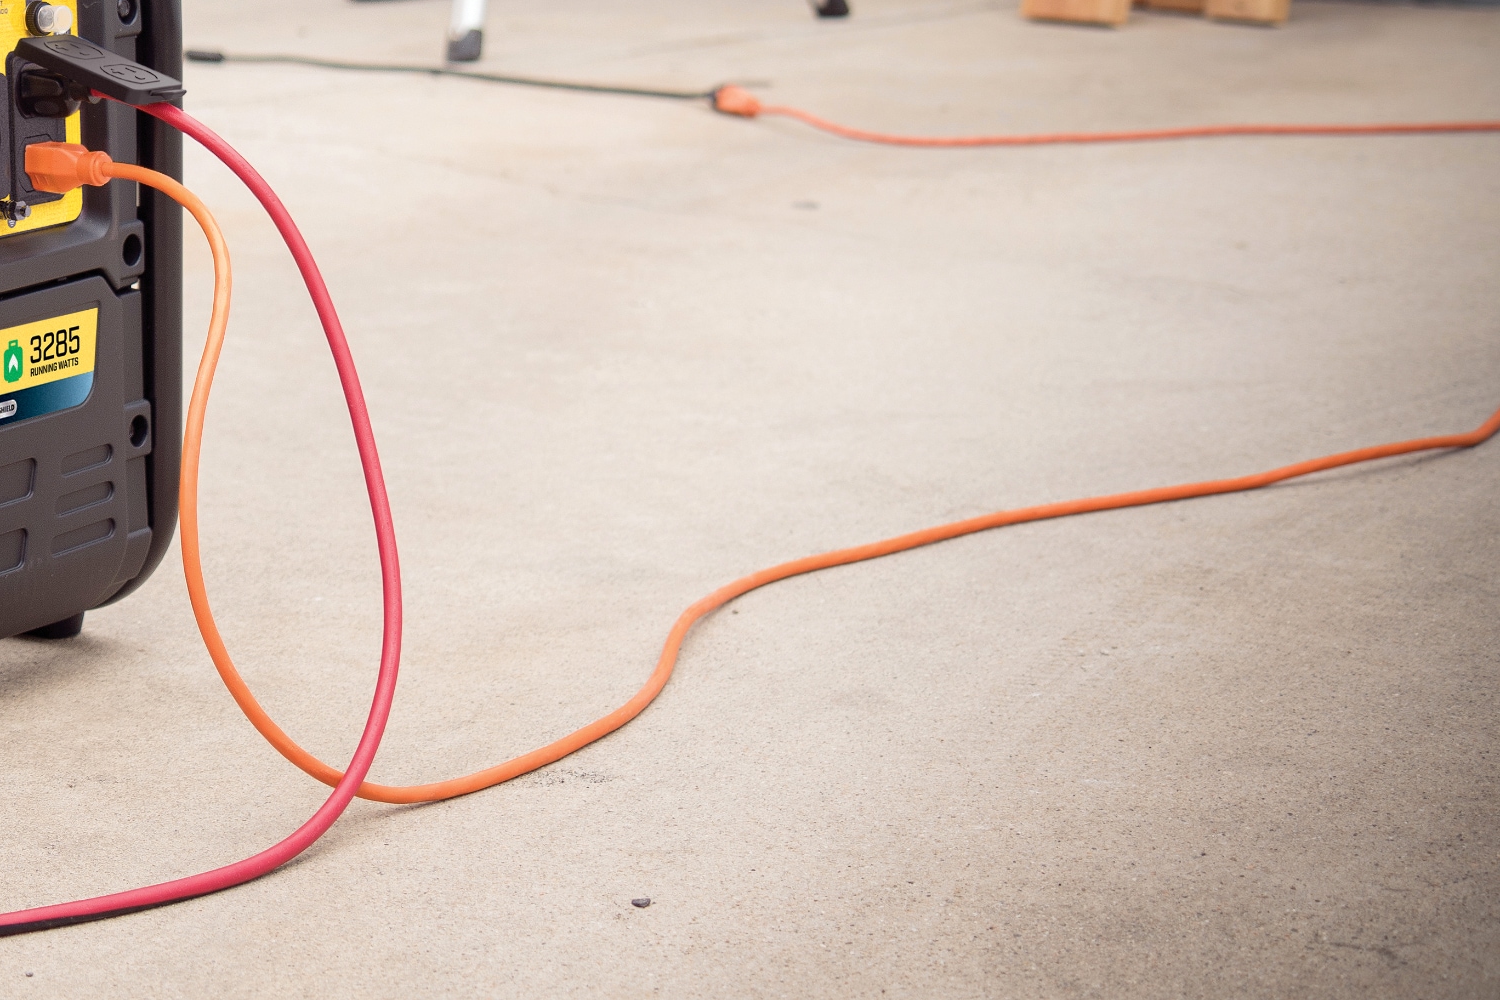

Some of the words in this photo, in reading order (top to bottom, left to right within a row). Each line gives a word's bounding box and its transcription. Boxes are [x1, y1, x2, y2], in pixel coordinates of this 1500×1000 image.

[30, 325, 80, 364] 3285
[30, 362, 58, 377] RUNNING
[58, 357, 79, 370] WATTS
